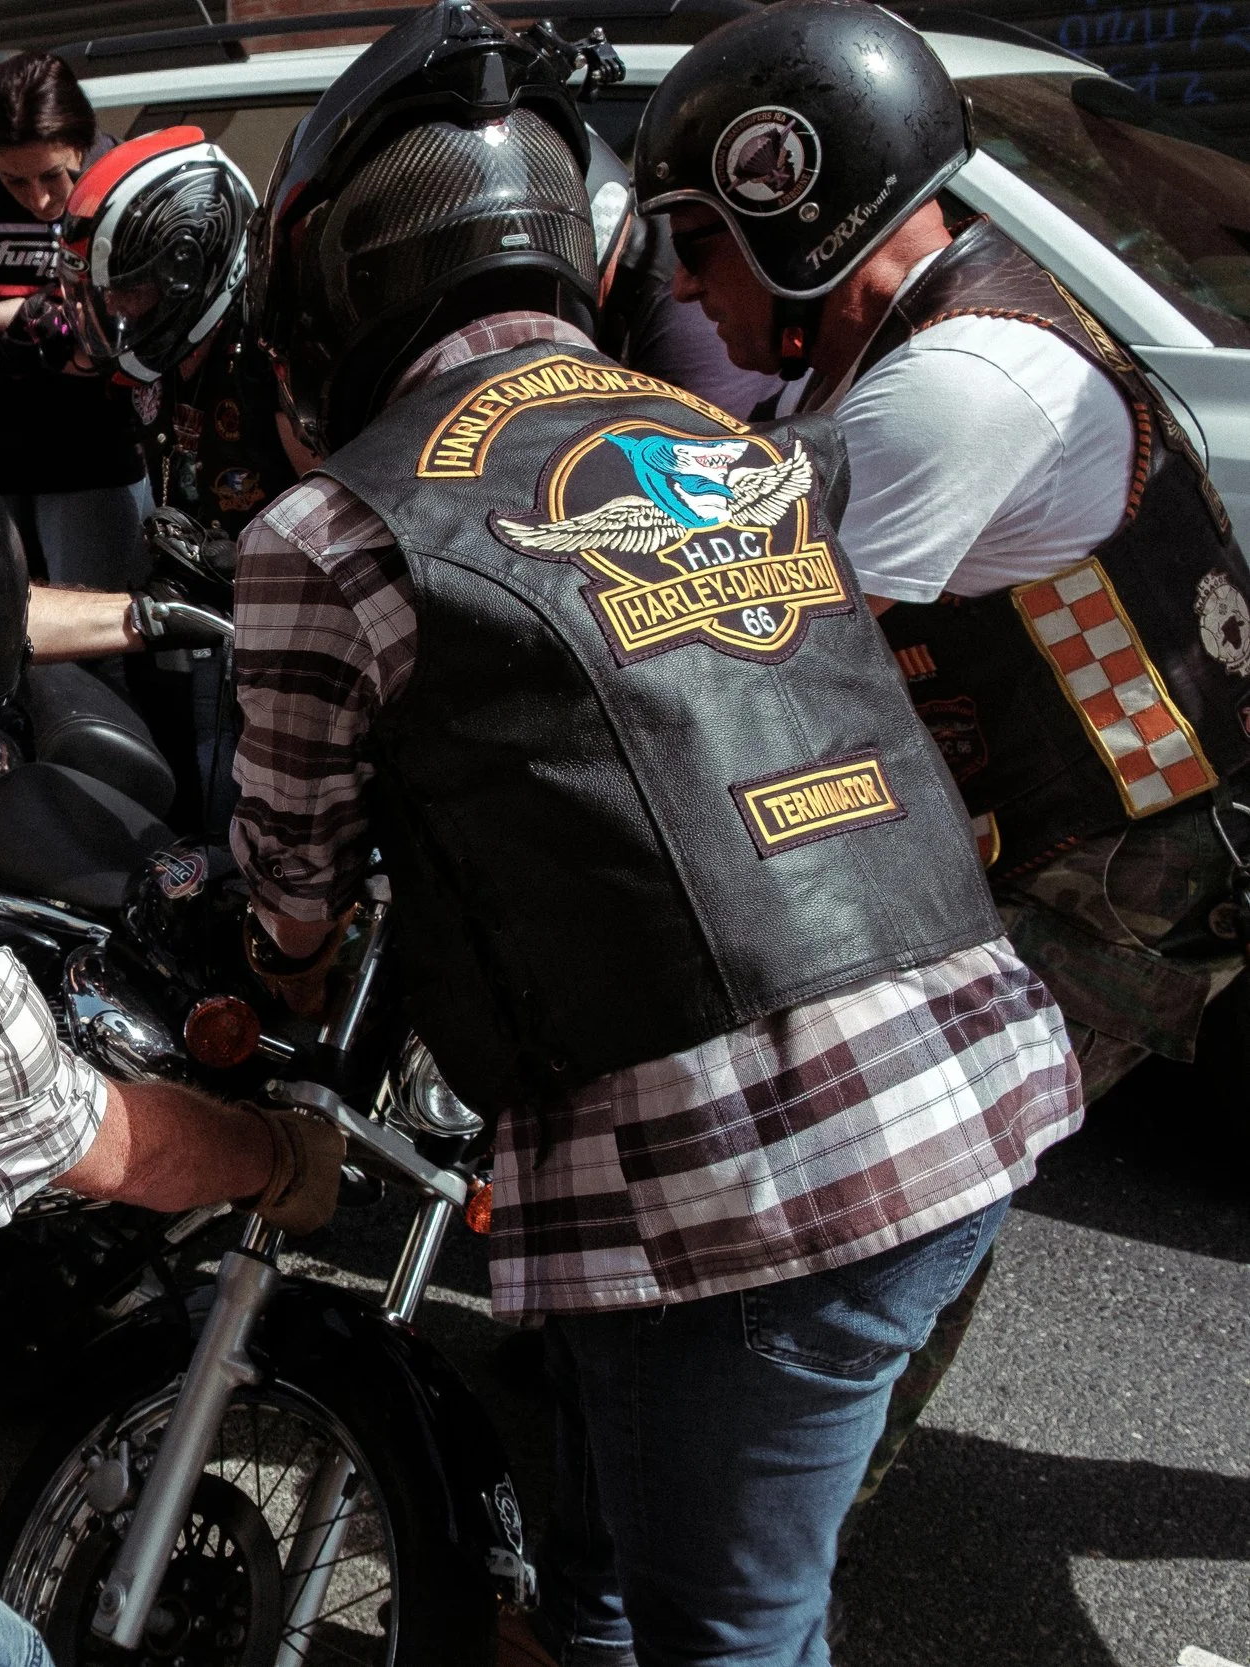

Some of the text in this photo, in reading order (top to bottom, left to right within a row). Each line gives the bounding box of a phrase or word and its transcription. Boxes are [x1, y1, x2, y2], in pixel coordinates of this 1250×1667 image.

[805, 204, 866, 270] TORX
[623, 557, 831, 630] HARLEY-DAVIDSON
[741, 606, 776, 636] 66
[763, 774, 883, 829] TERMINATOR
